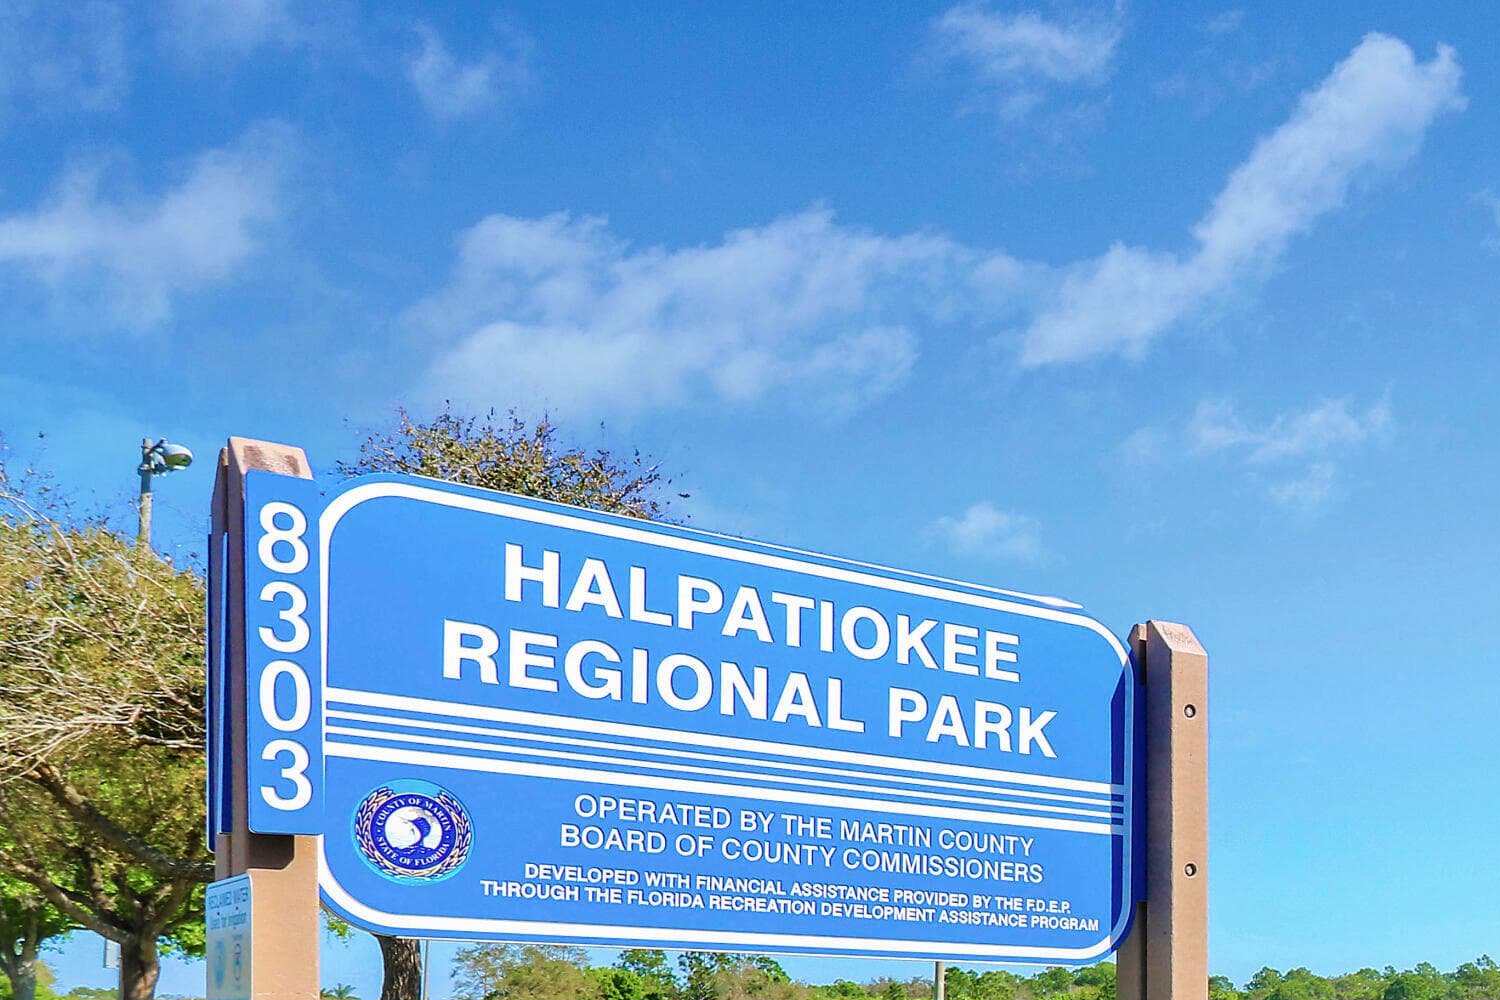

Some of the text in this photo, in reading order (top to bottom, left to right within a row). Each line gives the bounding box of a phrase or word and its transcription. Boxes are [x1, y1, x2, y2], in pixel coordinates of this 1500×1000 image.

[505, 542, 1021, 683] HALPATIOKEE
[258, 500, 314, 811] 8303
[442, 618, 1058, 759] REGIONAL PARK
[376, 797, 452, 832] COUNTY OF MARTIN
[574, 794, 1034, 857] OPERATED BY THE MARTIN COUNTY
[376, 836, 399, 860] STATE
[399, 857, 413, 866] OF
[560, 823, 1044, 884] BOARD OF COUNTY COMMISSIONERS
[480, 880, 1099, 931] THROUGH THE FLORIDA RECREATION DEVELOPMENT ASSISTANCE PROGRAM
[524, 863, 1071, 914] DEVELOPED WITH FINANCIAL ASSISTANCE PROVIDED BY THE F.D.E.P.
